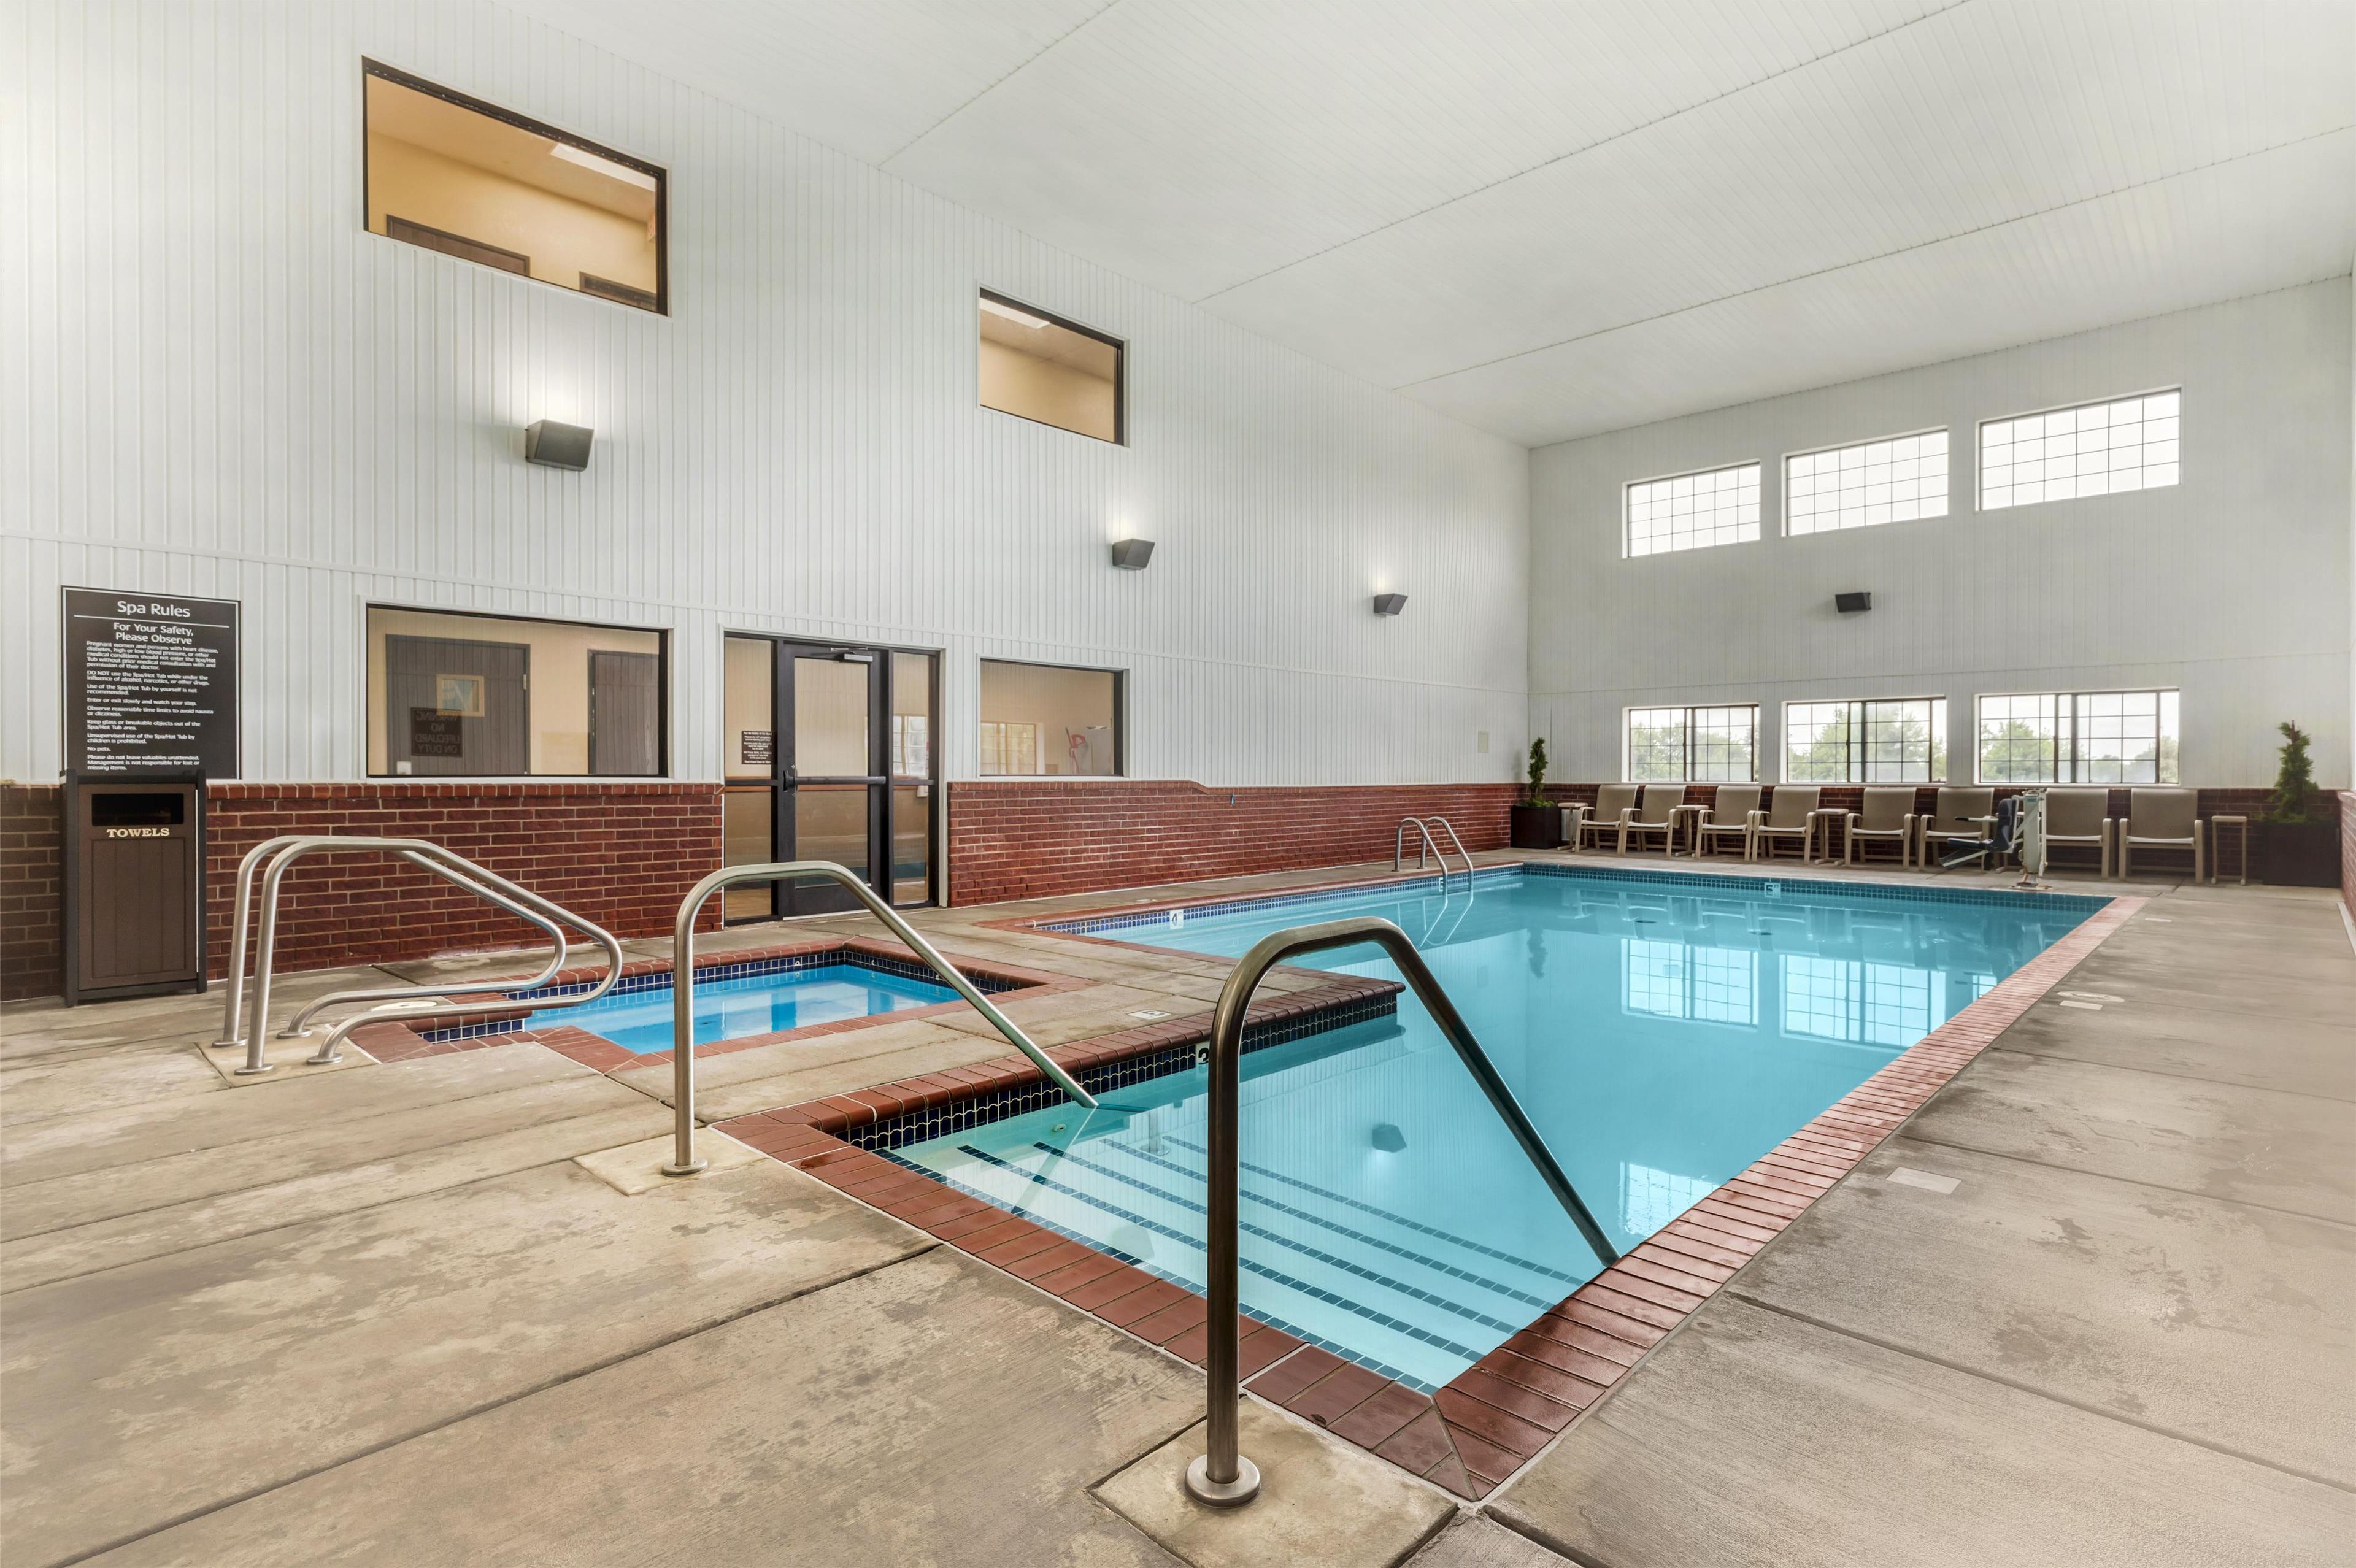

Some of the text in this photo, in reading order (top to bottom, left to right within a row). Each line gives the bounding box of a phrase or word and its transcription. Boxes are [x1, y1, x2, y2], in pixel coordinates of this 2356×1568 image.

[117, 601, 191, 617] Spa Rules
[114, 622, 194, 637] For Your Safety,
[115, 632, 192, 644] Please Observe
[106, 828, 171, 838] TOWELS
